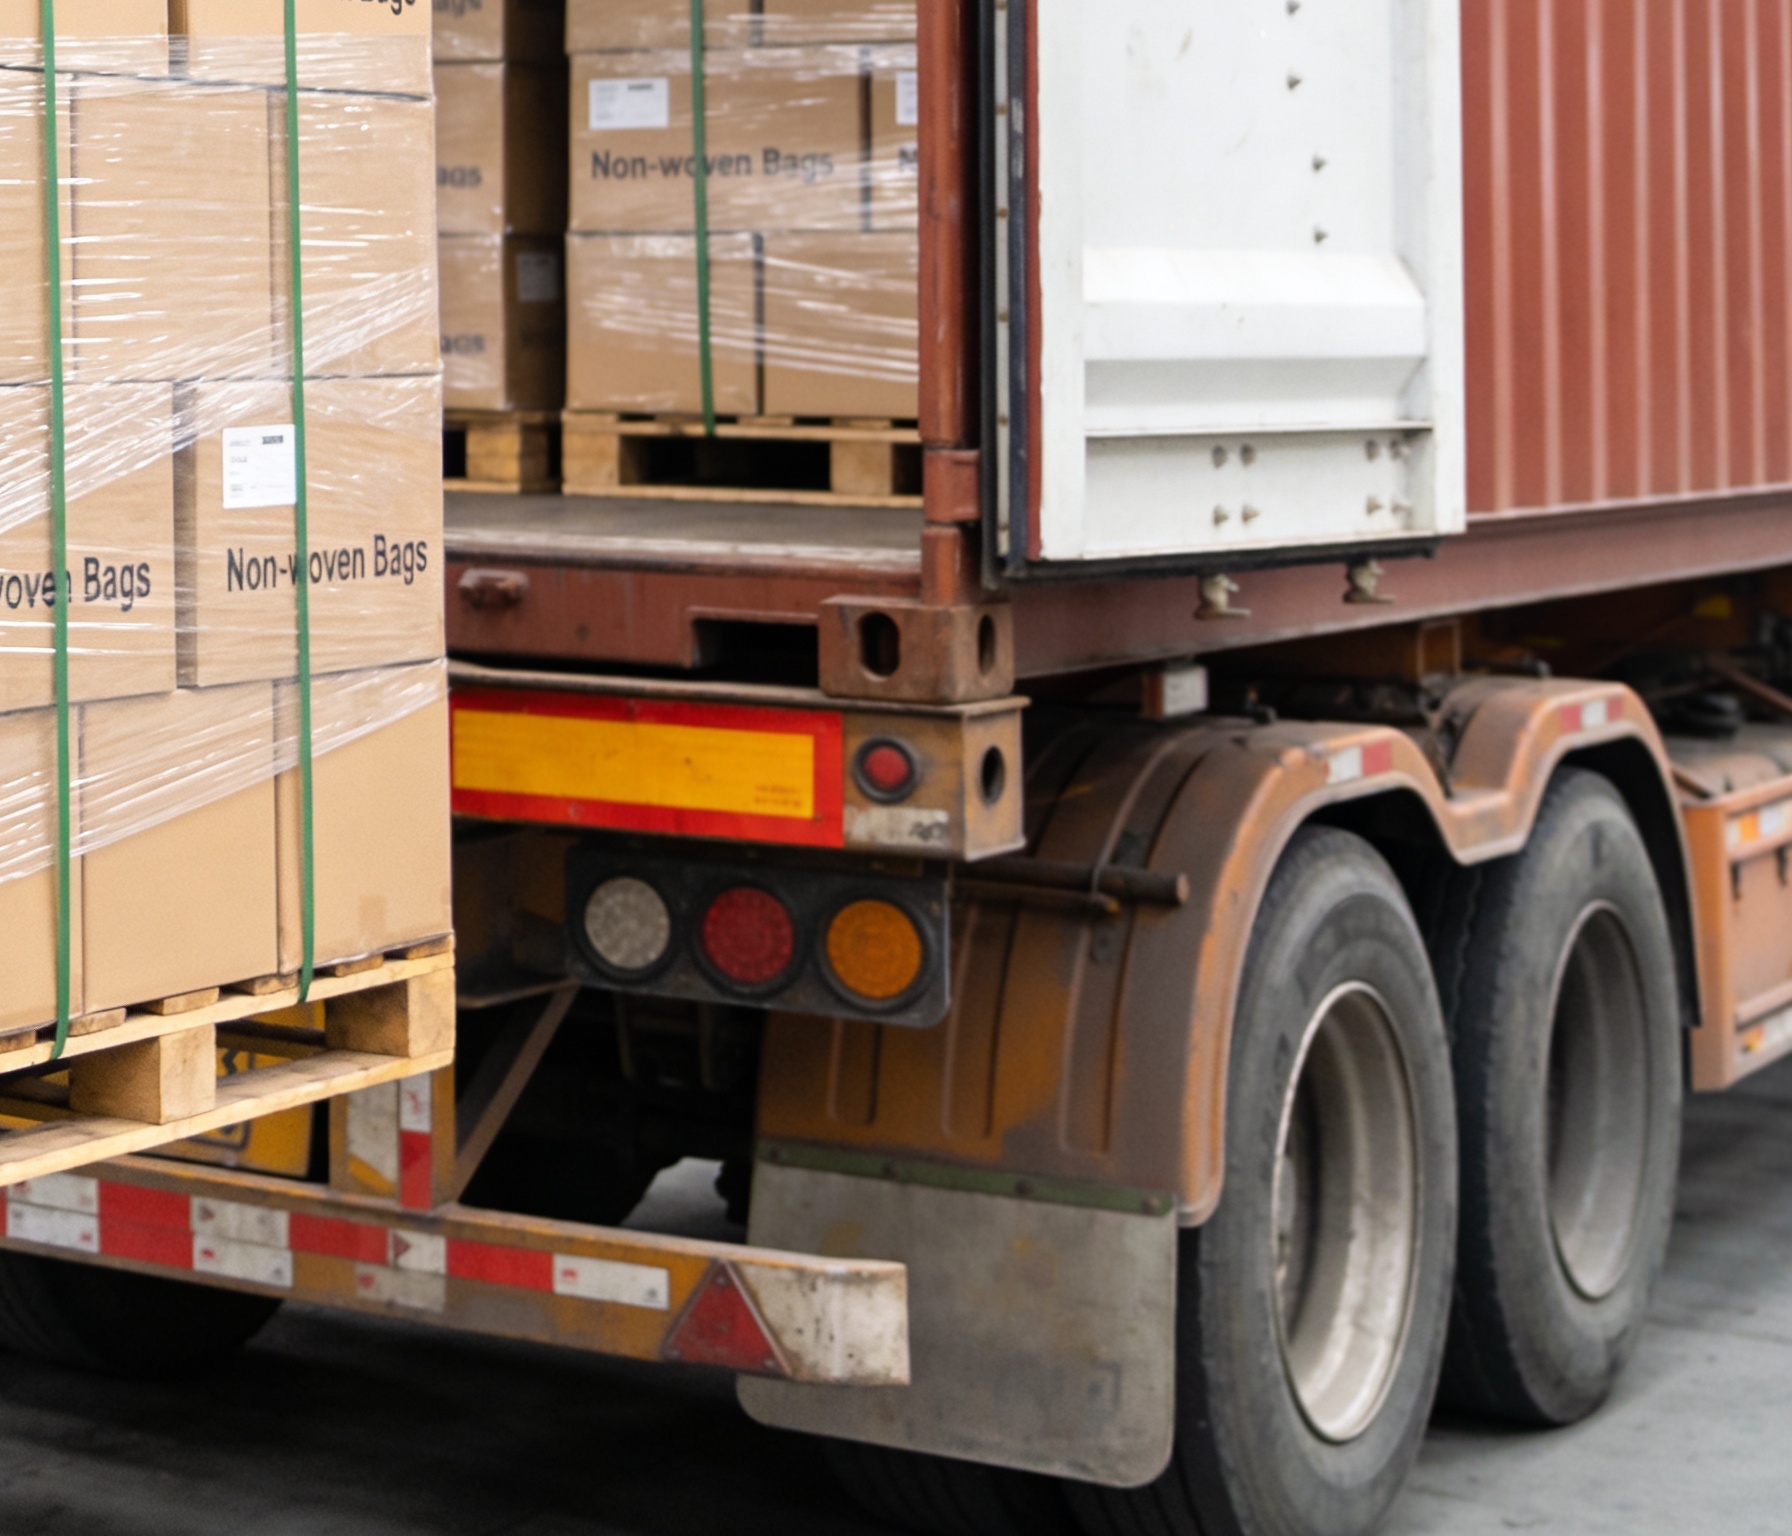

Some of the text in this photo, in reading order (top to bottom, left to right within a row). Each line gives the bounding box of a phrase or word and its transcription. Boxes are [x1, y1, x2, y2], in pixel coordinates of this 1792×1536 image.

[762, 147, 834, 183] Bags
[84, 557, 151, 612] Bags
[373, 533, 427, 586] Bags
